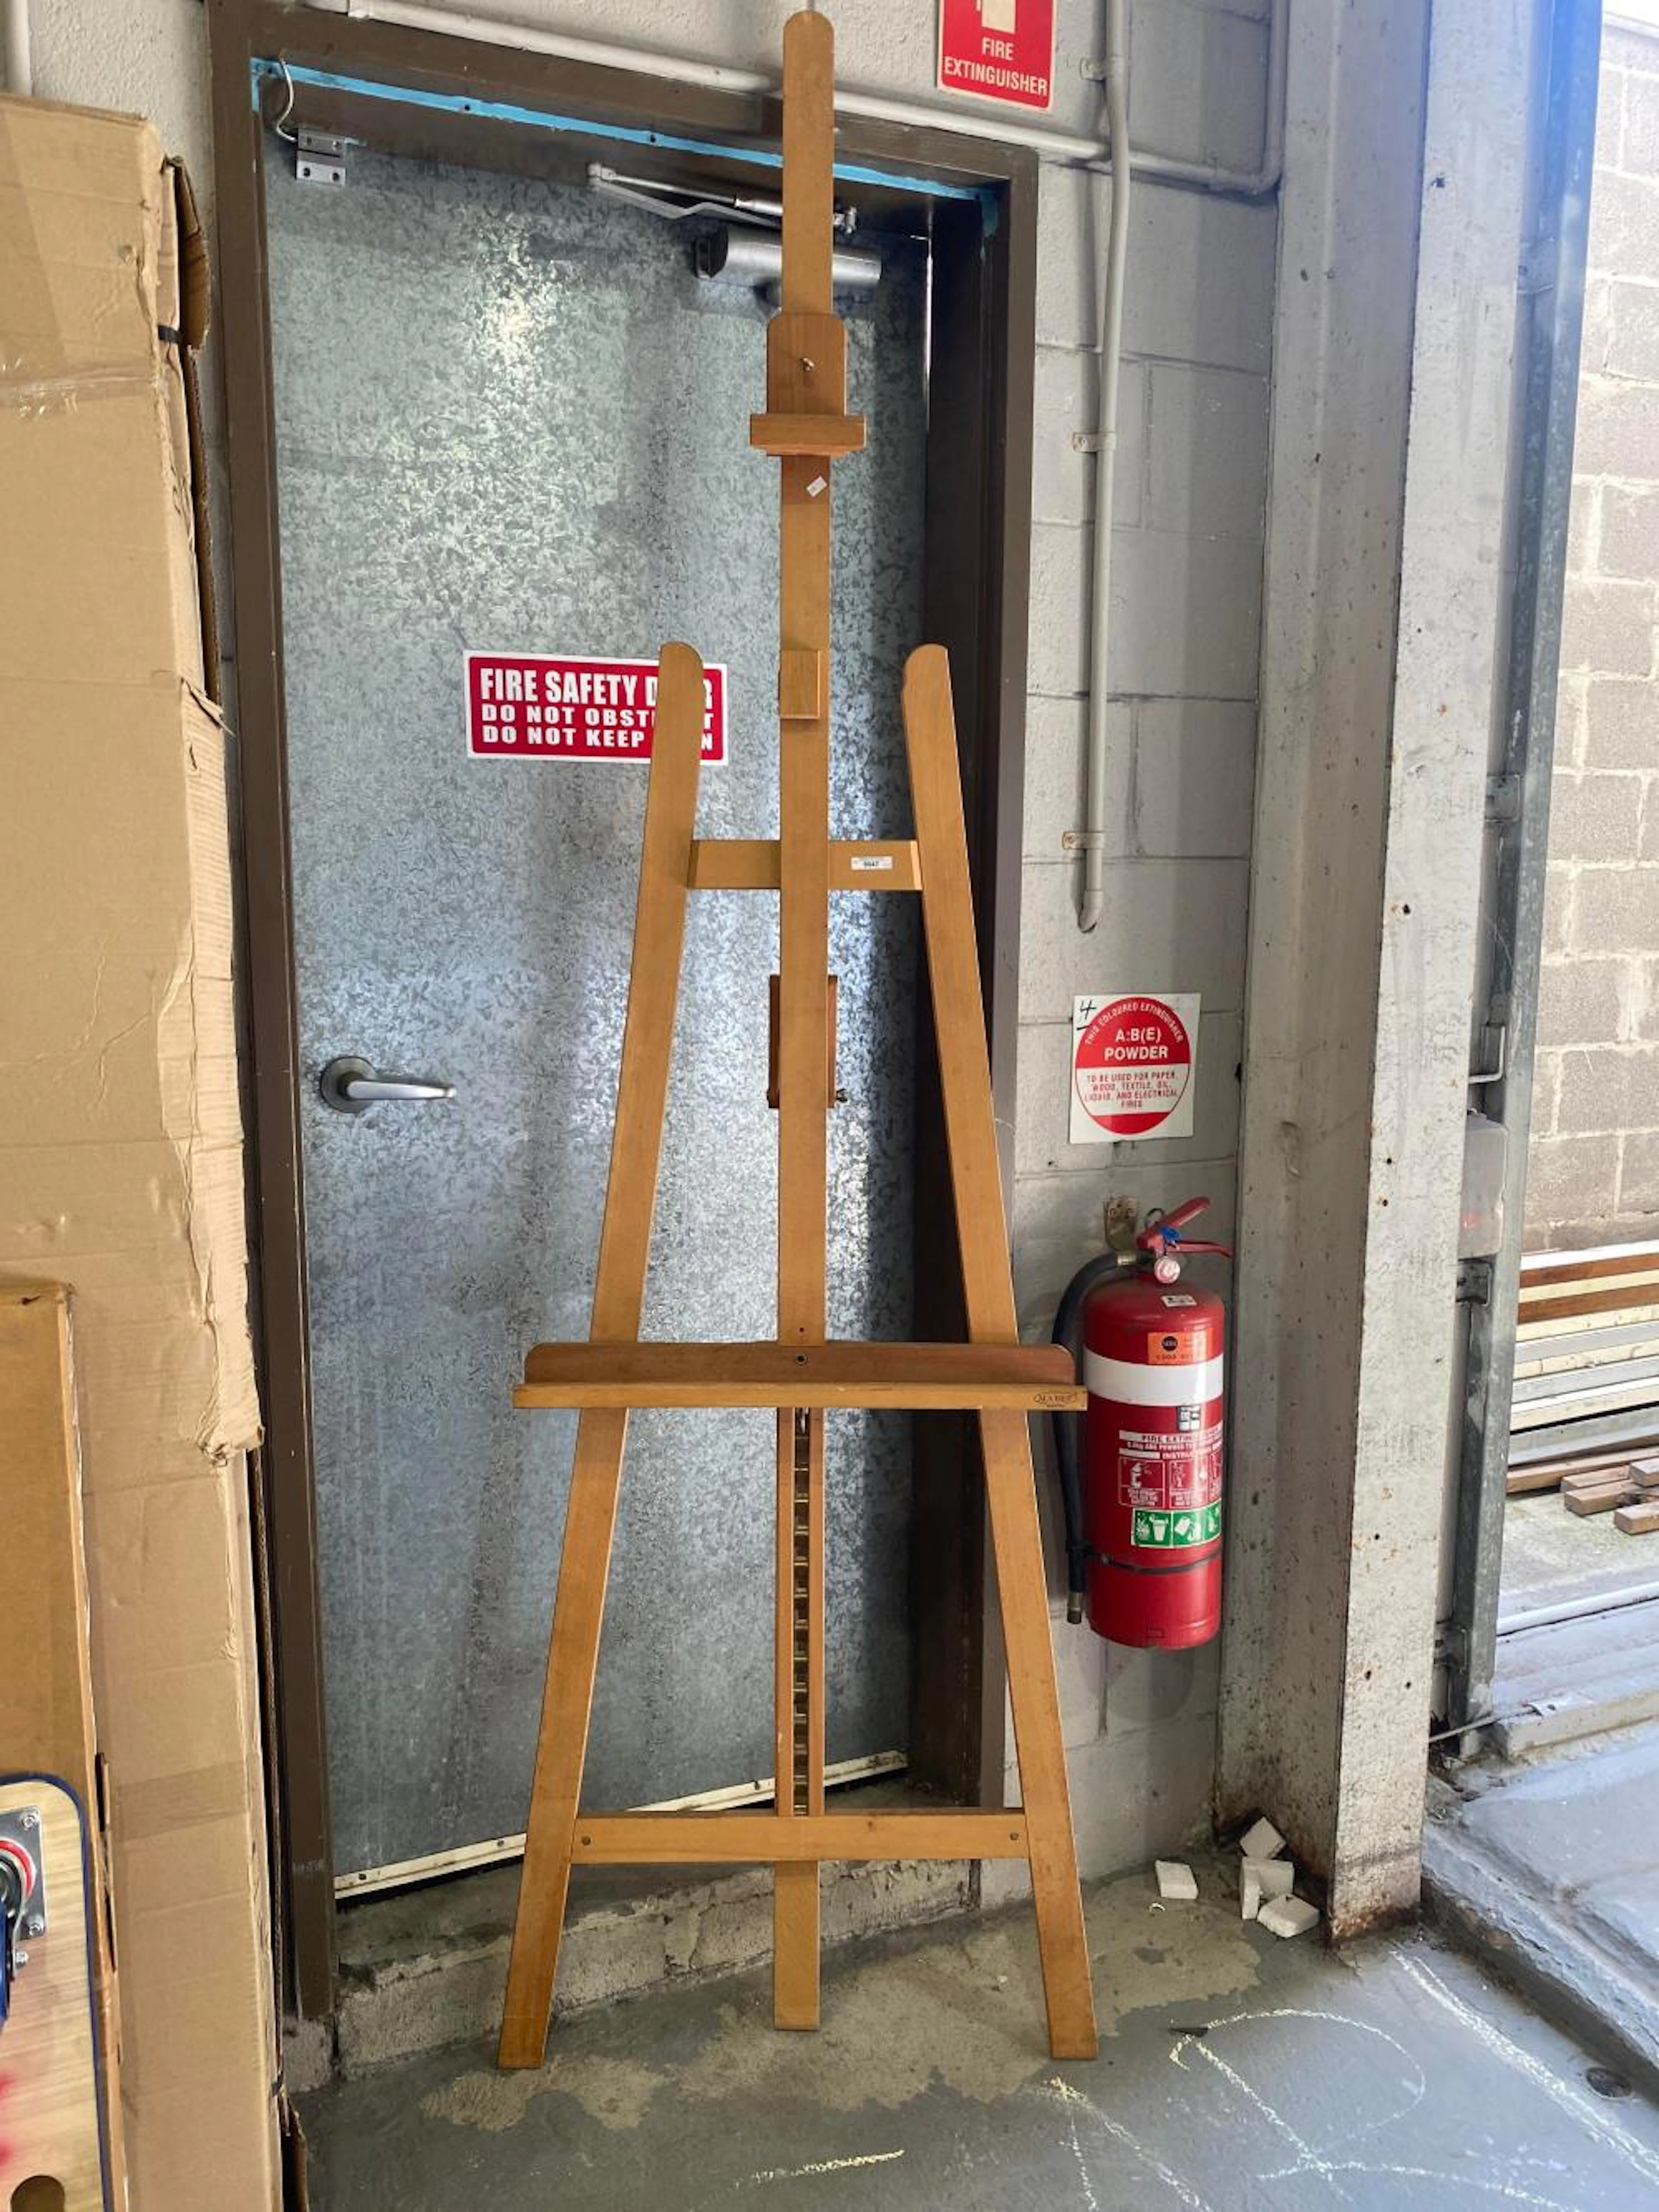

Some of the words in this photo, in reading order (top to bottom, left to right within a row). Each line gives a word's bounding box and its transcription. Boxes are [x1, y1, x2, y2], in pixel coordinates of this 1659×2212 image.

[982, 37, 1014, 60] FIRE
[944, 56, 1048, 96] EXTINGUISHER
[480, 668, 538, 701] FIRE
[545, 670, 637, 706] SAFETY
[482, 703, 515, 722] DO
[527, 705, 575, 725] NOT
[585, 707, 714, 729] OBSTT
[482, 725, 517, 744] DO
[527, 726, 577, 746] NOT
[585, 729, 645, 748] KEEP
[1103, 1045, 1169, 1061] POWDER
[1112, 1073, 1132, 1082] USED
[1135, 1072, 1148, 1081] FOR
